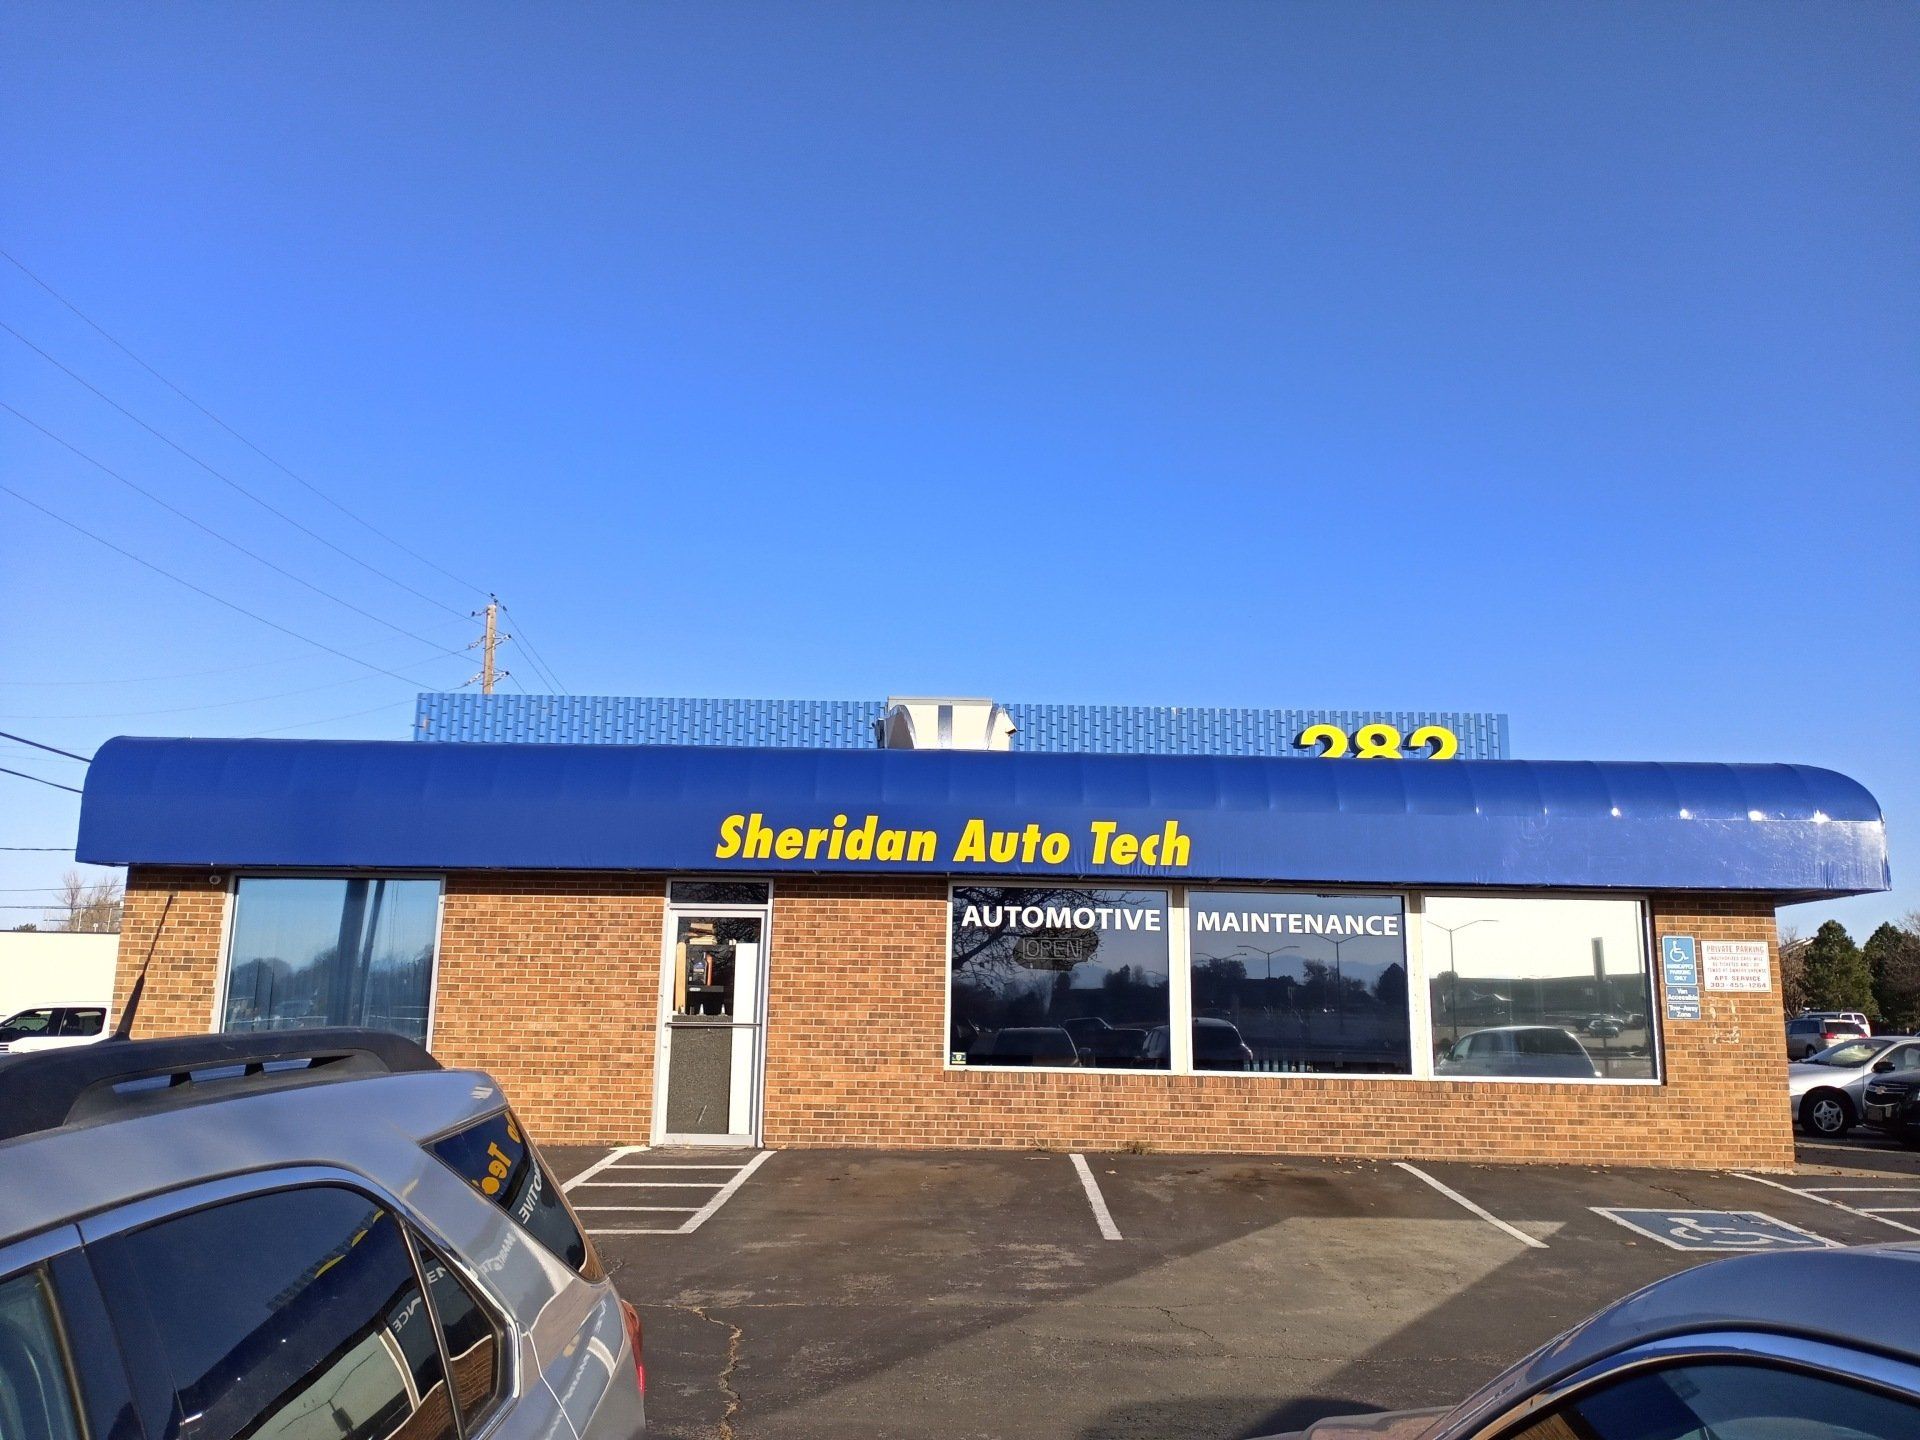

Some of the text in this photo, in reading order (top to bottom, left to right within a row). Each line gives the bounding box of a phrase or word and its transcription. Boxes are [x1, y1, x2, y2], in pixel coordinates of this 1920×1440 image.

[715, 813, 1191, 867] Sheridan Auto Tech
[961, 905, 1399, 936] AUTOMOTIVE MAINTENANCE
[1026, 939, 1080, 958] OPEN
[1706, 945, 1764, 954] PRIVATE PARKING
